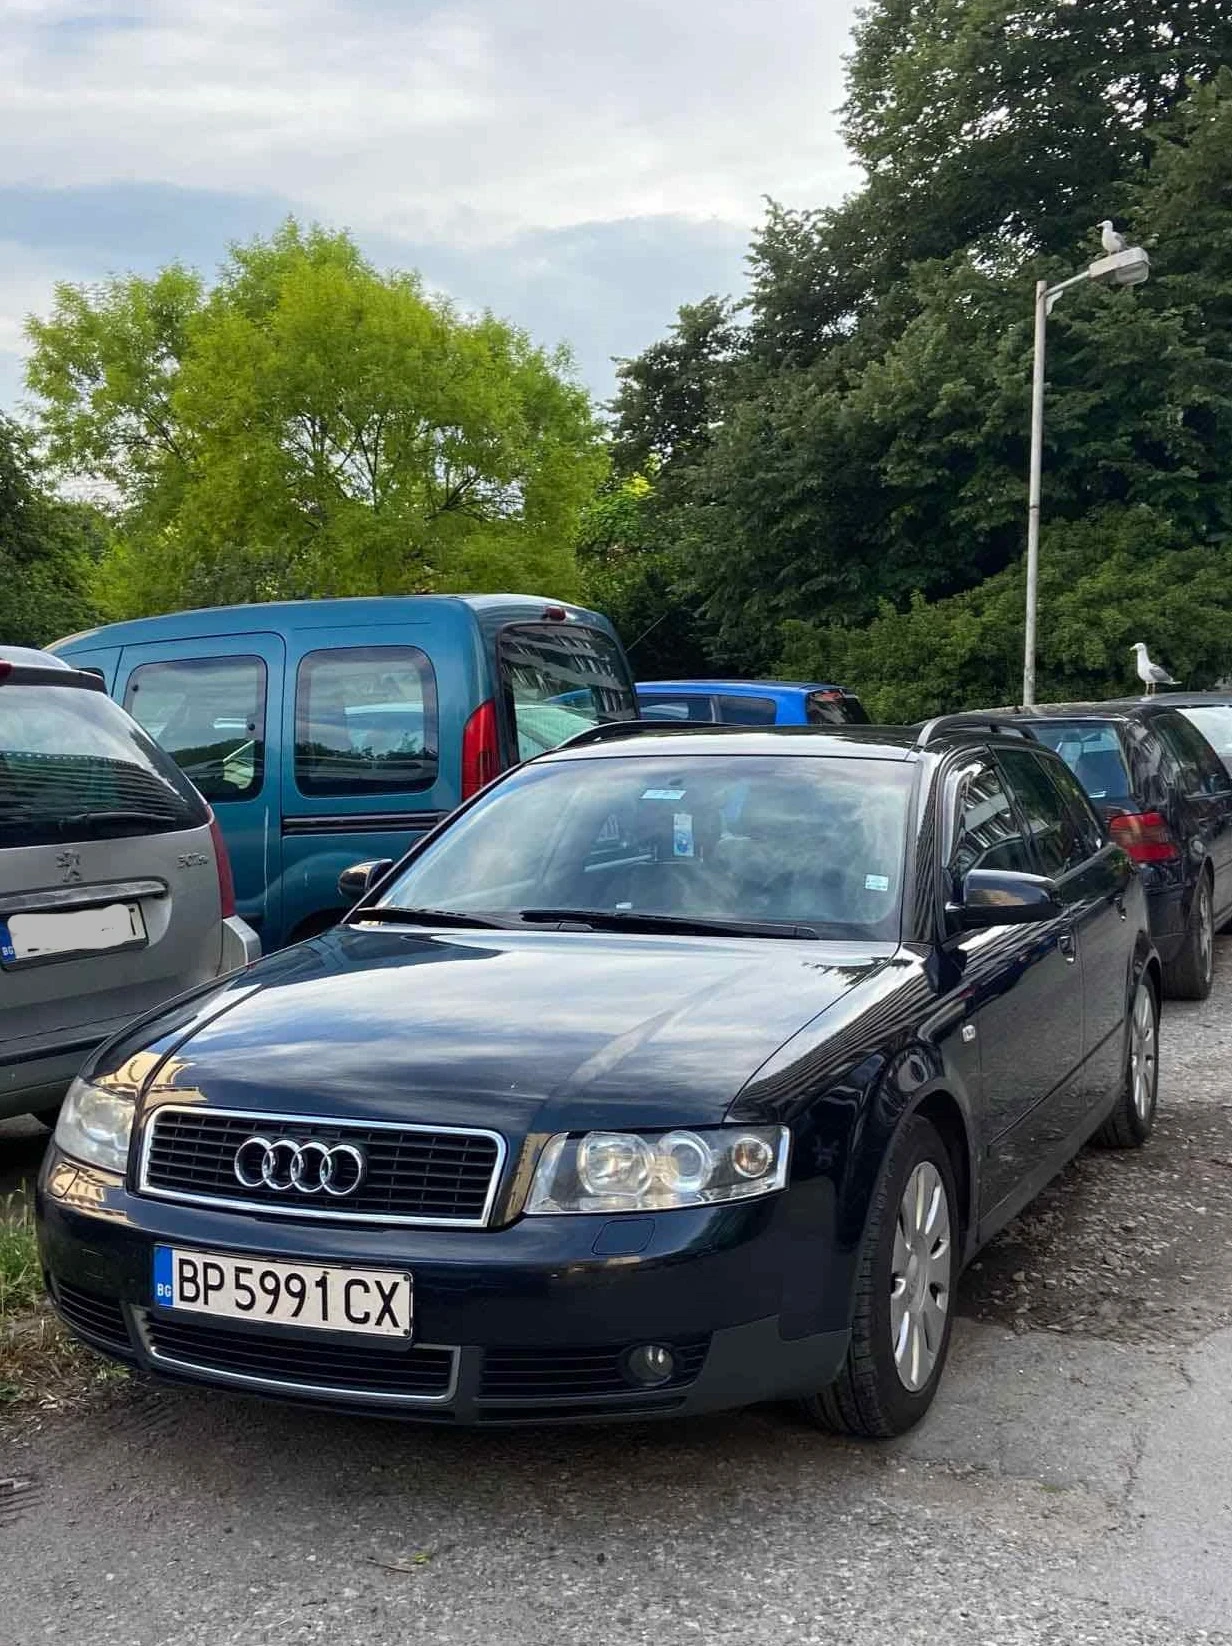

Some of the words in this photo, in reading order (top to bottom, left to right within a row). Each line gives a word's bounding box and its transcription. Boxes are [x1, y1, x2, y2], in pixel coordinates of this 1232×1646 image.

[157, 1283, 171, 1297] BG
[178, 1258, 225, 1306] BP
[234, 1266, 329, 1322] 5991
[344, 1278, 400, 1328] CX
